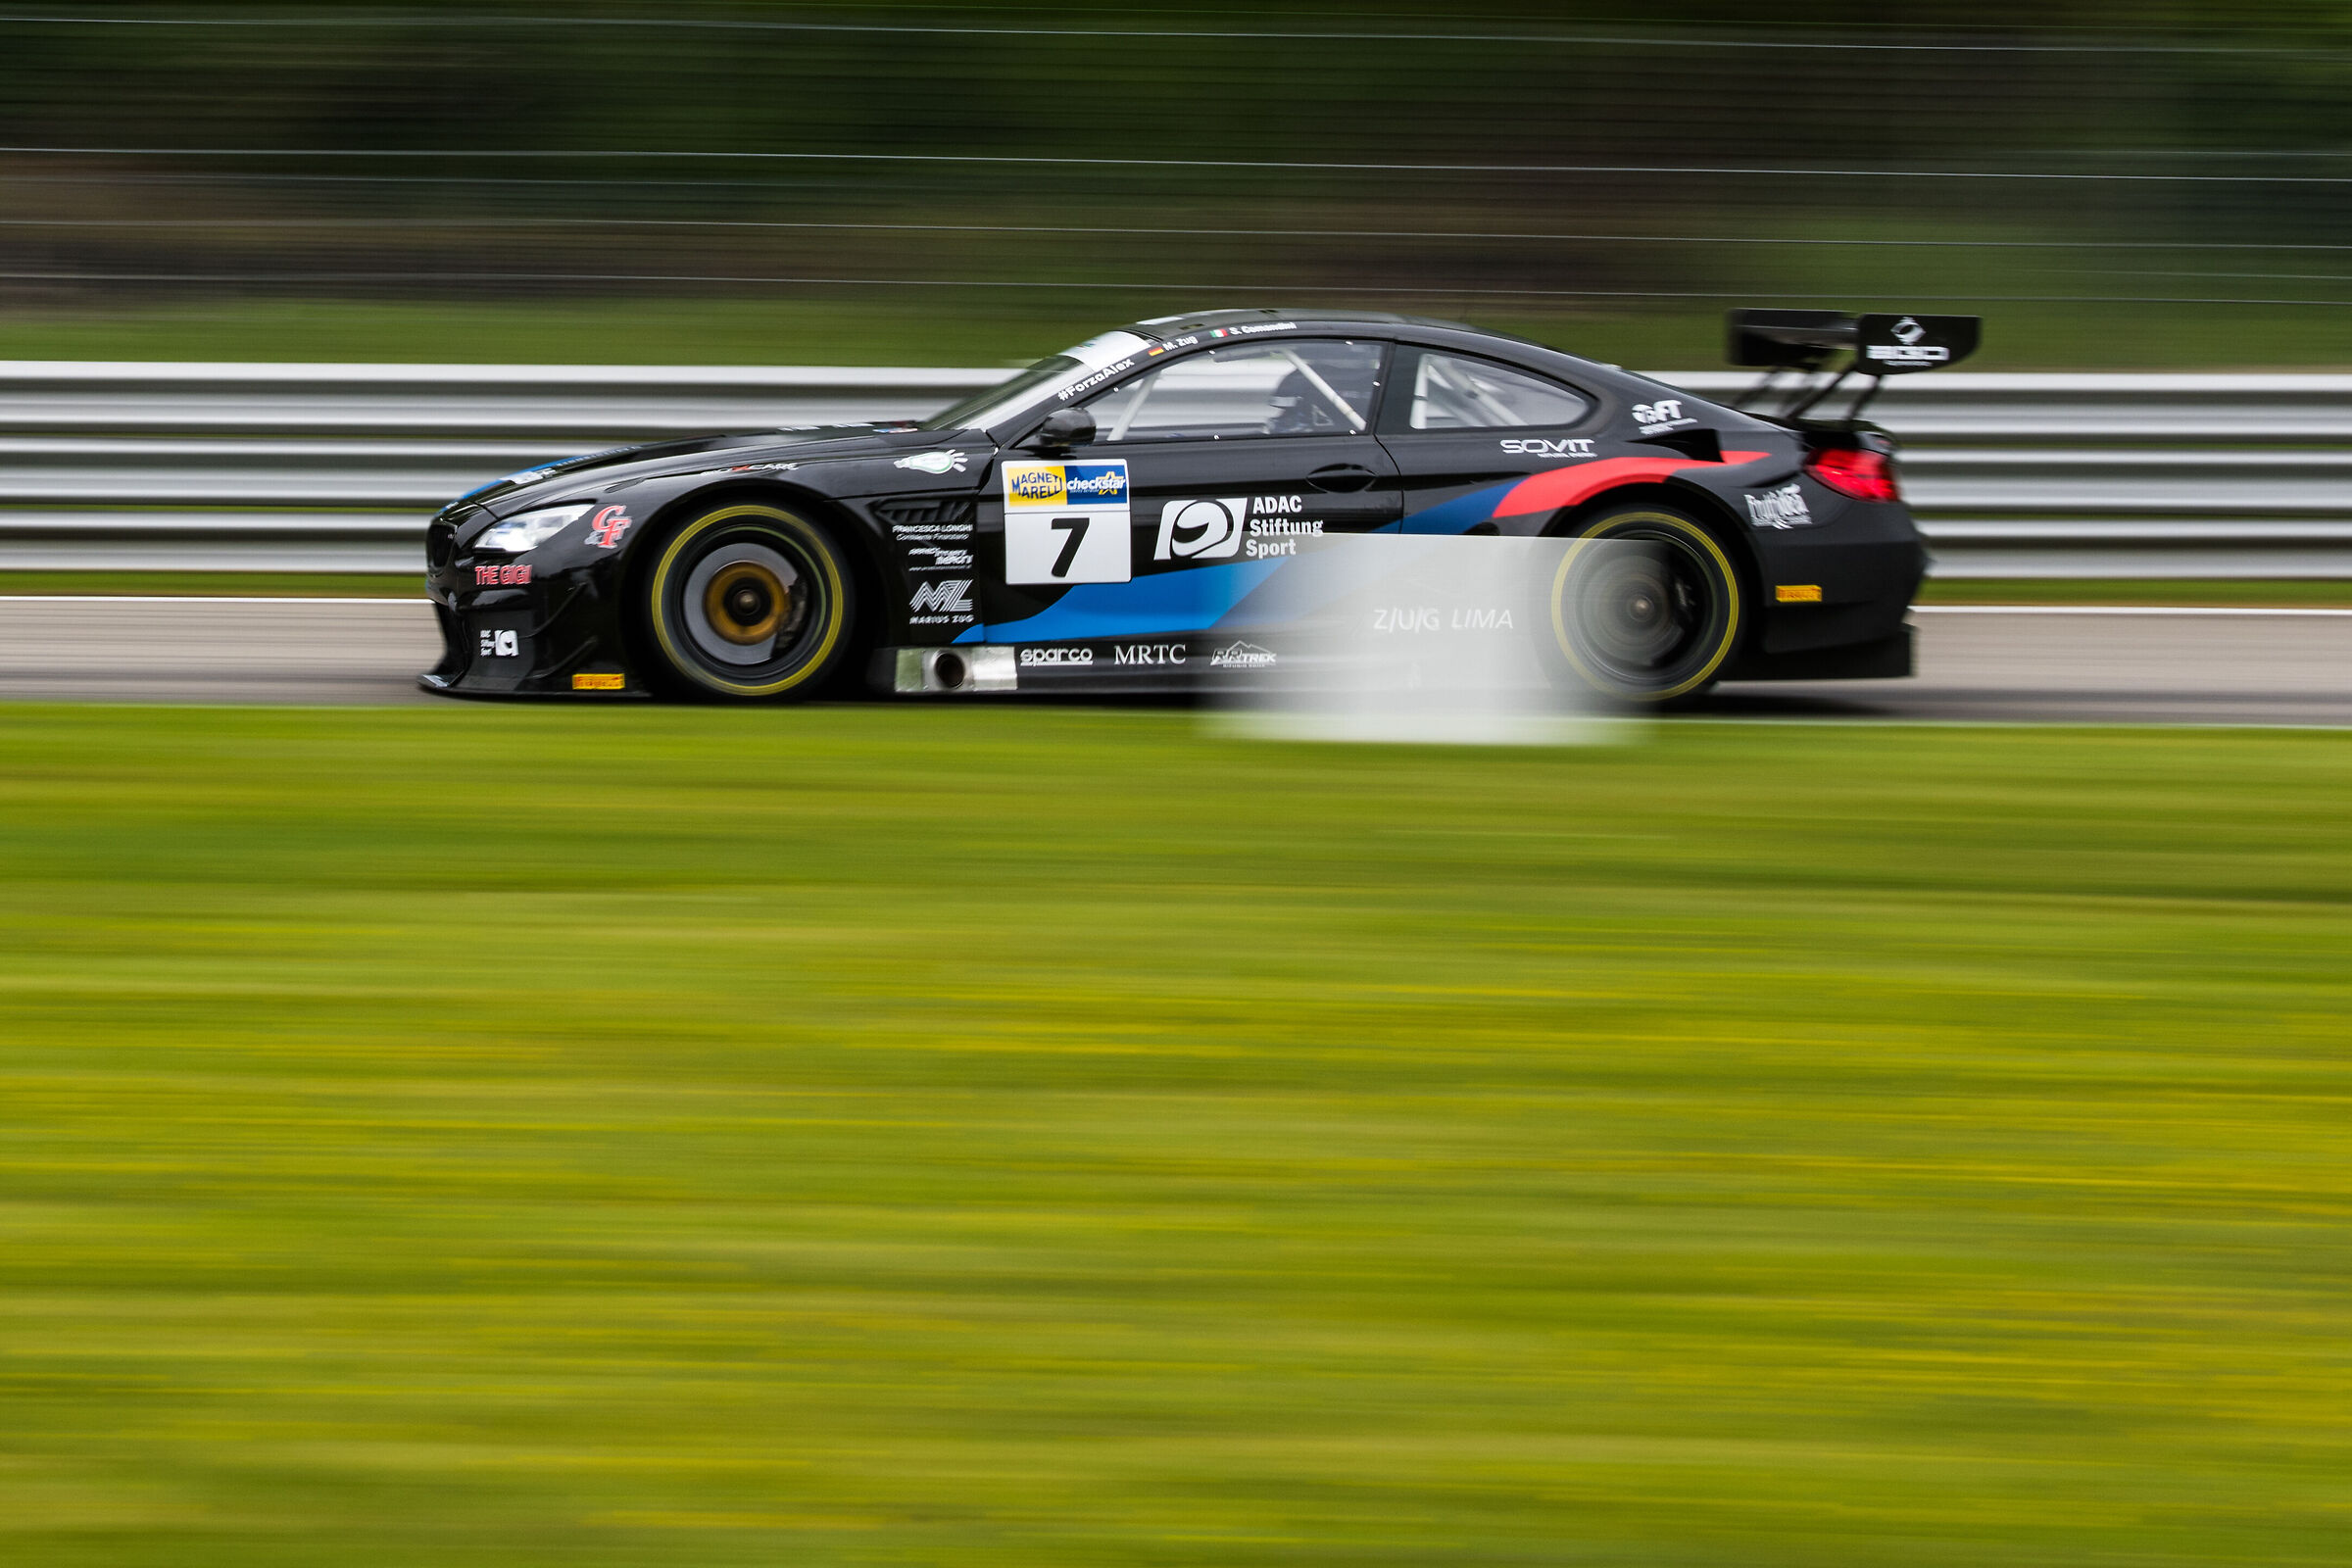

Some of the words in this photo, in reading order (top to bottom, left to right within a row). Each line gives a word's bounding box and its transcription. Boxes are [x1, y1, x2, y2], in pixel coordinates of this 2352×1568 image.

[1162, 342, 1178, 352] M.
[1177, 335, 1199, 347] Zug
[1057, 359, 1135, 402] #ForzaAlex
[1500, 439, 1595, 454] SOVIT
[1067, 476, 1126, 490] checkstar
[1252, 495, 1302, 514] ADAC
[1250, 518, 1323, 537] Stiftung
[1051, 517, 1090, 578] 7
[1246, 539, 1297, 559] Sport
[474, 565, 499, 585] THE
[909, 615, 950, 624] MARIUS
[952, 614, 974, 623] ZUG
[1450, 609, 1514, 629] LIMA
[1020, 648, 1094, 666] sparco
[1113, 644, 1187, 665] MRTC
